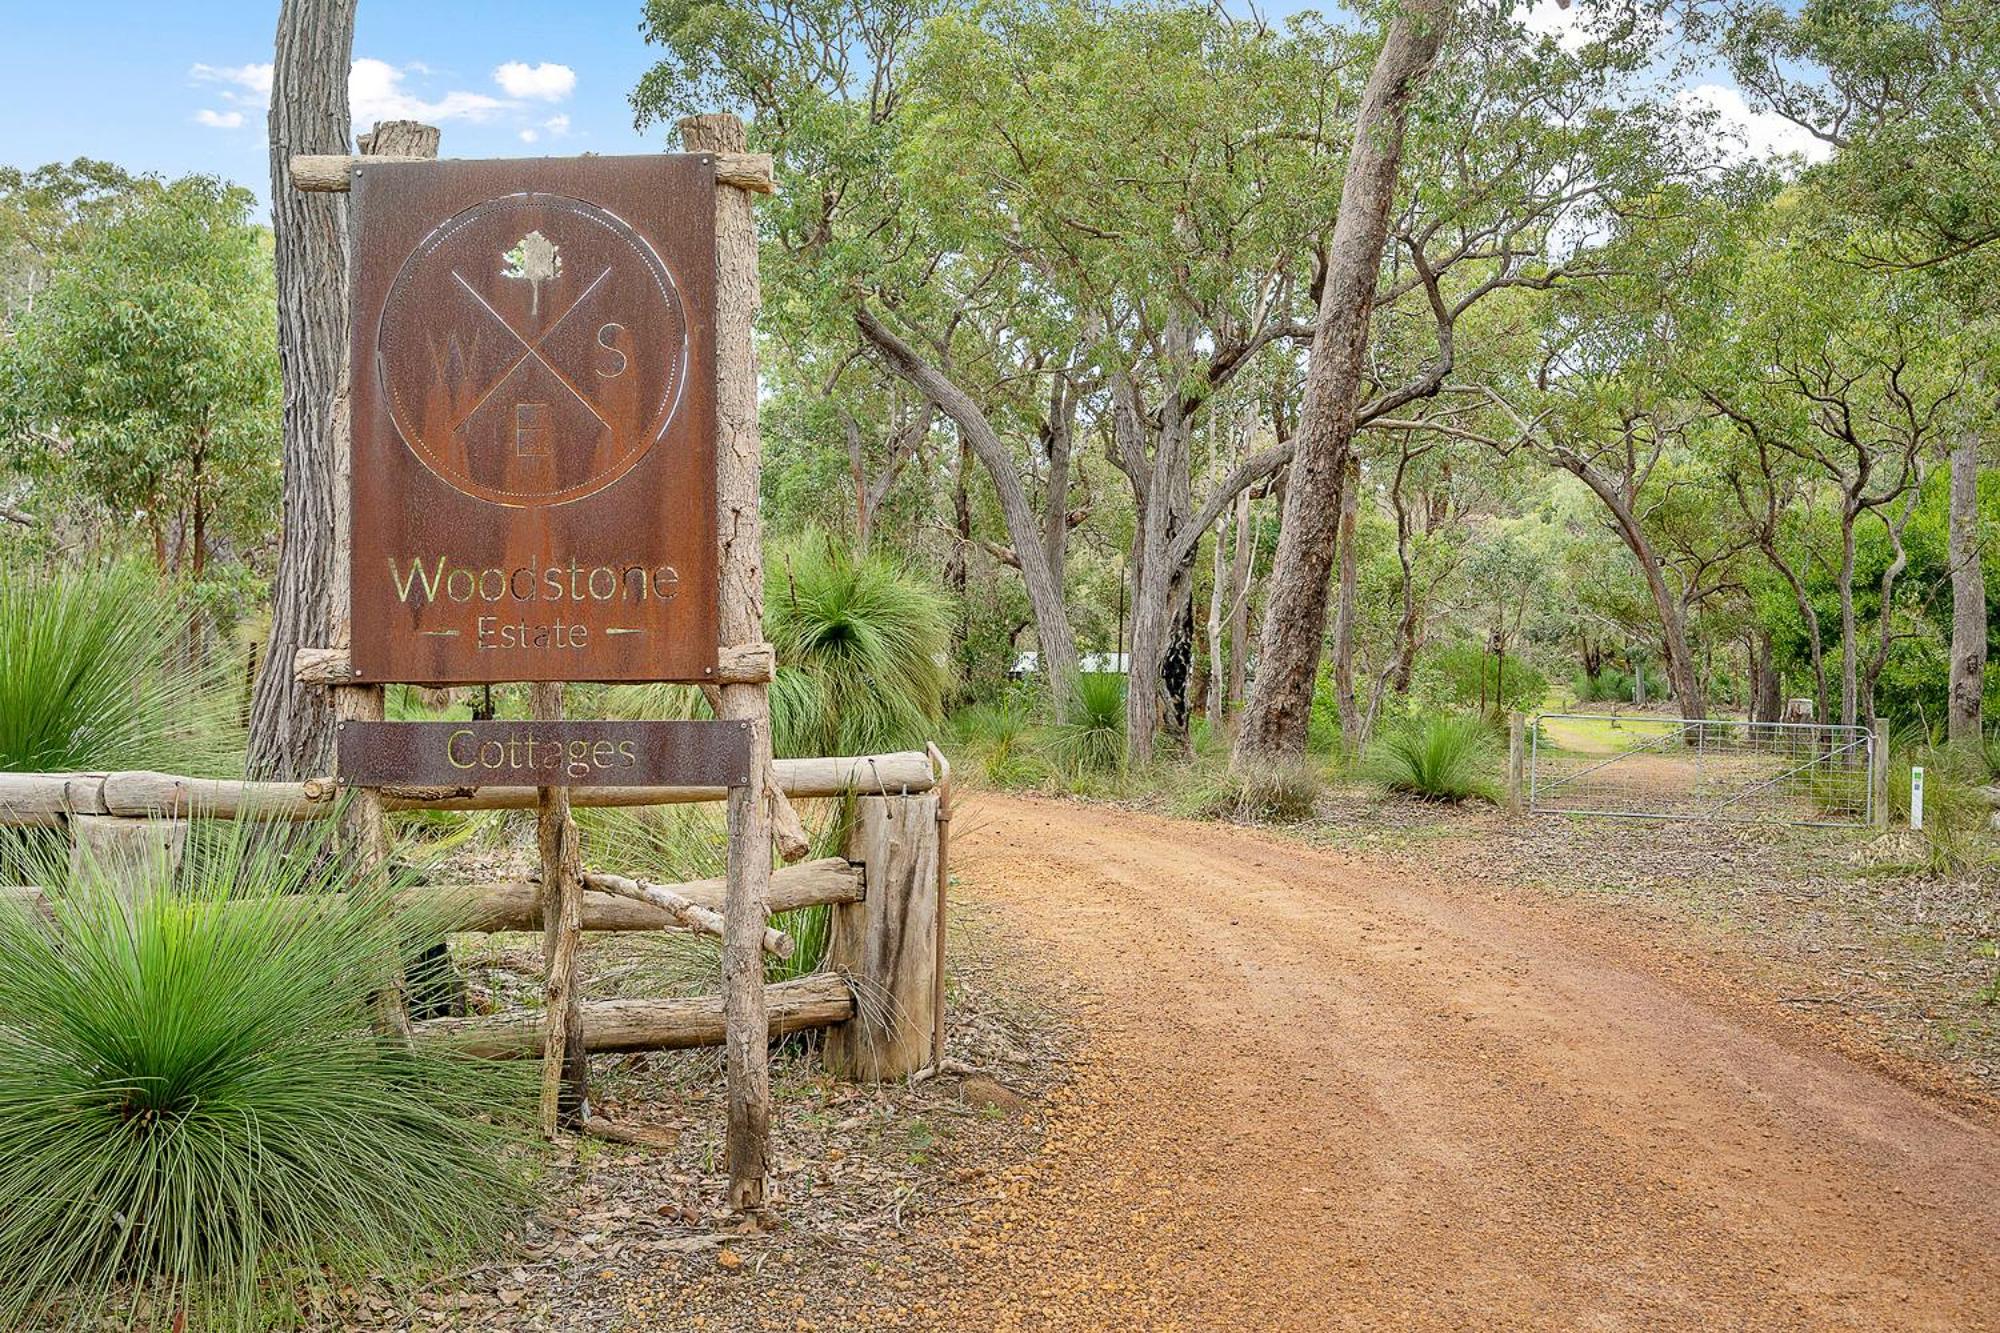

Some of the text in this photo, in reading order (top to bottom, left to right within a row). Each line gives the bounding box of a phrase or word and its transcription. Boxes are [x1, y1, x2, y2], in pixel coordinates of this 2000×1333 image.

[425, 326, 482, 385] W
[595, 322, 628, 379] S
[516, 402, 553, 457] E
[387, 554, 681, 603] Woodstone
[477, 615, 590, 650] Estate
[447, 729, 637, 779] Cottages
